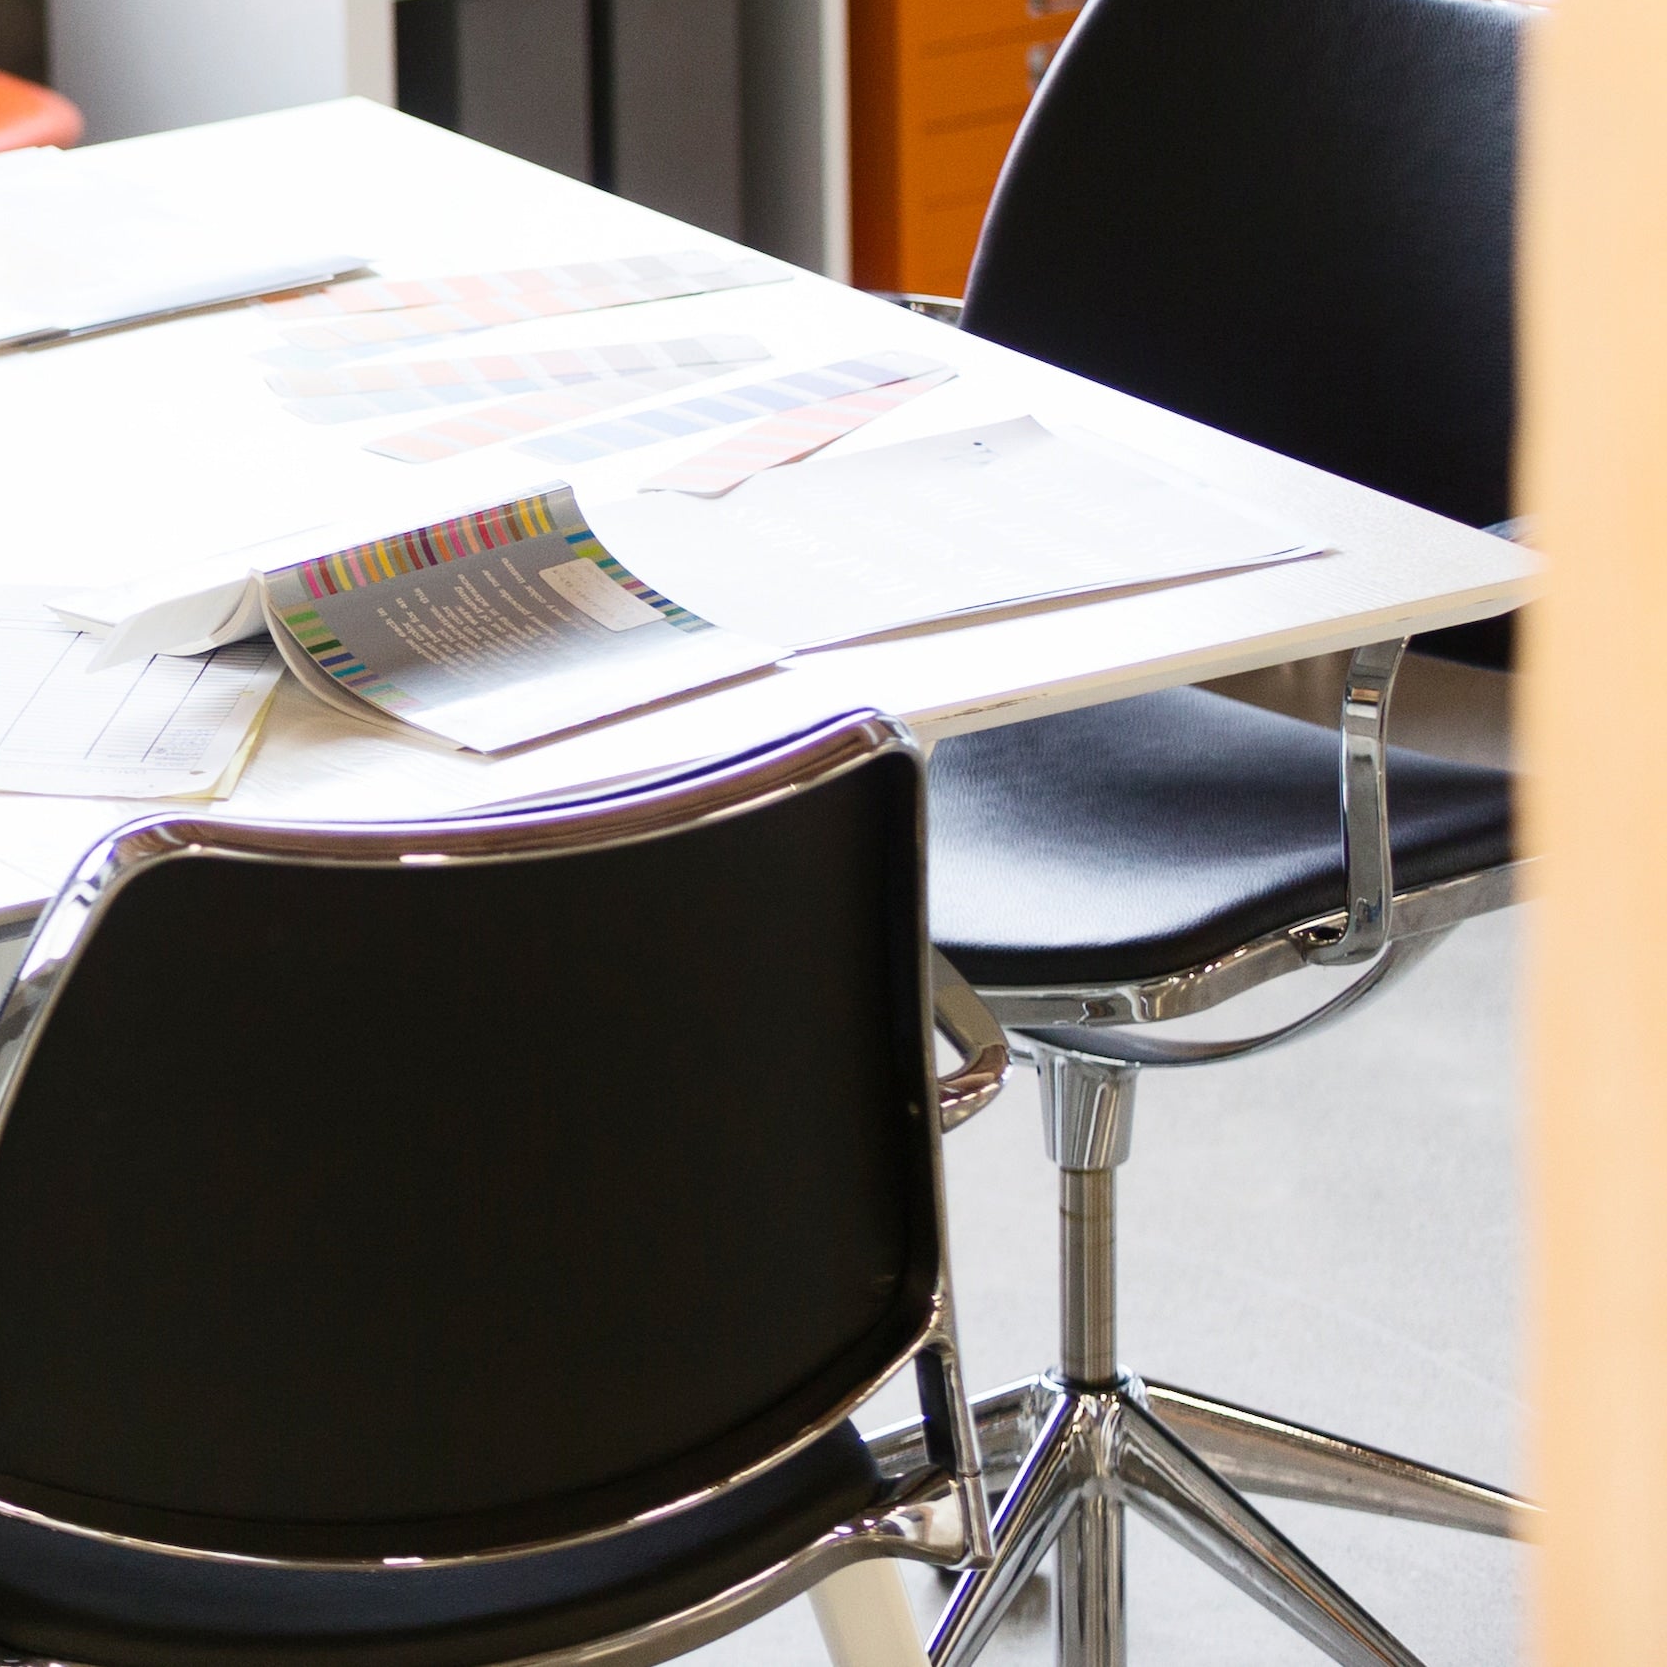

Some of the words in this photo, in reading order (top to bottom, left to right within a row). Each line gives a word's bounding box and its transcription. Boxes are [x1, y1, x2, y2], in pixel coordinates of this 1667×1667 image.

[482, 570, 501, 586] new
[414, 587, 430, 603] this
[458, 573, 490, 607] advance
[526, 585, 548, 603] color
[396, 597, 408, 609] an
[454, 586, 484, 613] putting
[500, 588, 532, 615] provide
[377, 607, 386, 616] in
[407, 611, 419, 622] for
[443, 606, 465, 624] color
[546, 604, 572, 621] every
[386, 617, 407, 637] each
[404, 622, 425, 640] color
[419, 624, 442, 642] basis
[462, 625, 482, 639] with
[491, 623, 506, 632] out
[405, 638, 441, 663] combine
